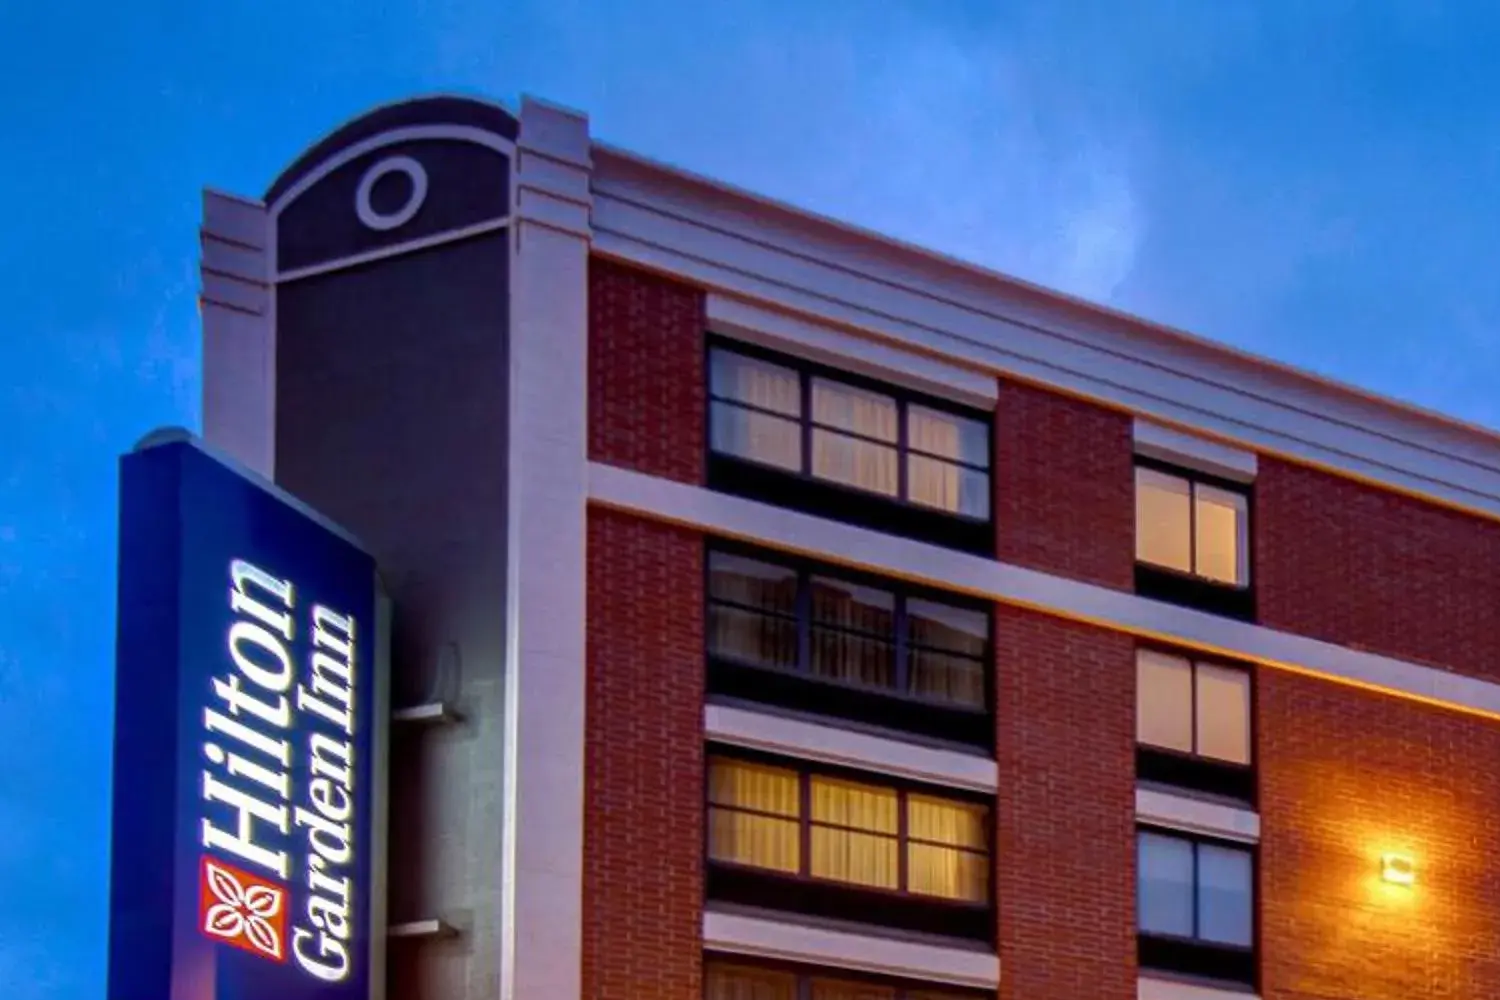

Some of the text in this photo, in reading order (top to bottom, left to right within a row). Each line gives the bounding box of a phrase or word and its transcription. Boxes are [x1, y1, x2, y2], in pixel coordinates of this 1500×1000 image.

[201, 558, 293, 880] Hilton
[292, 603, 355, 981] Garden Inn
